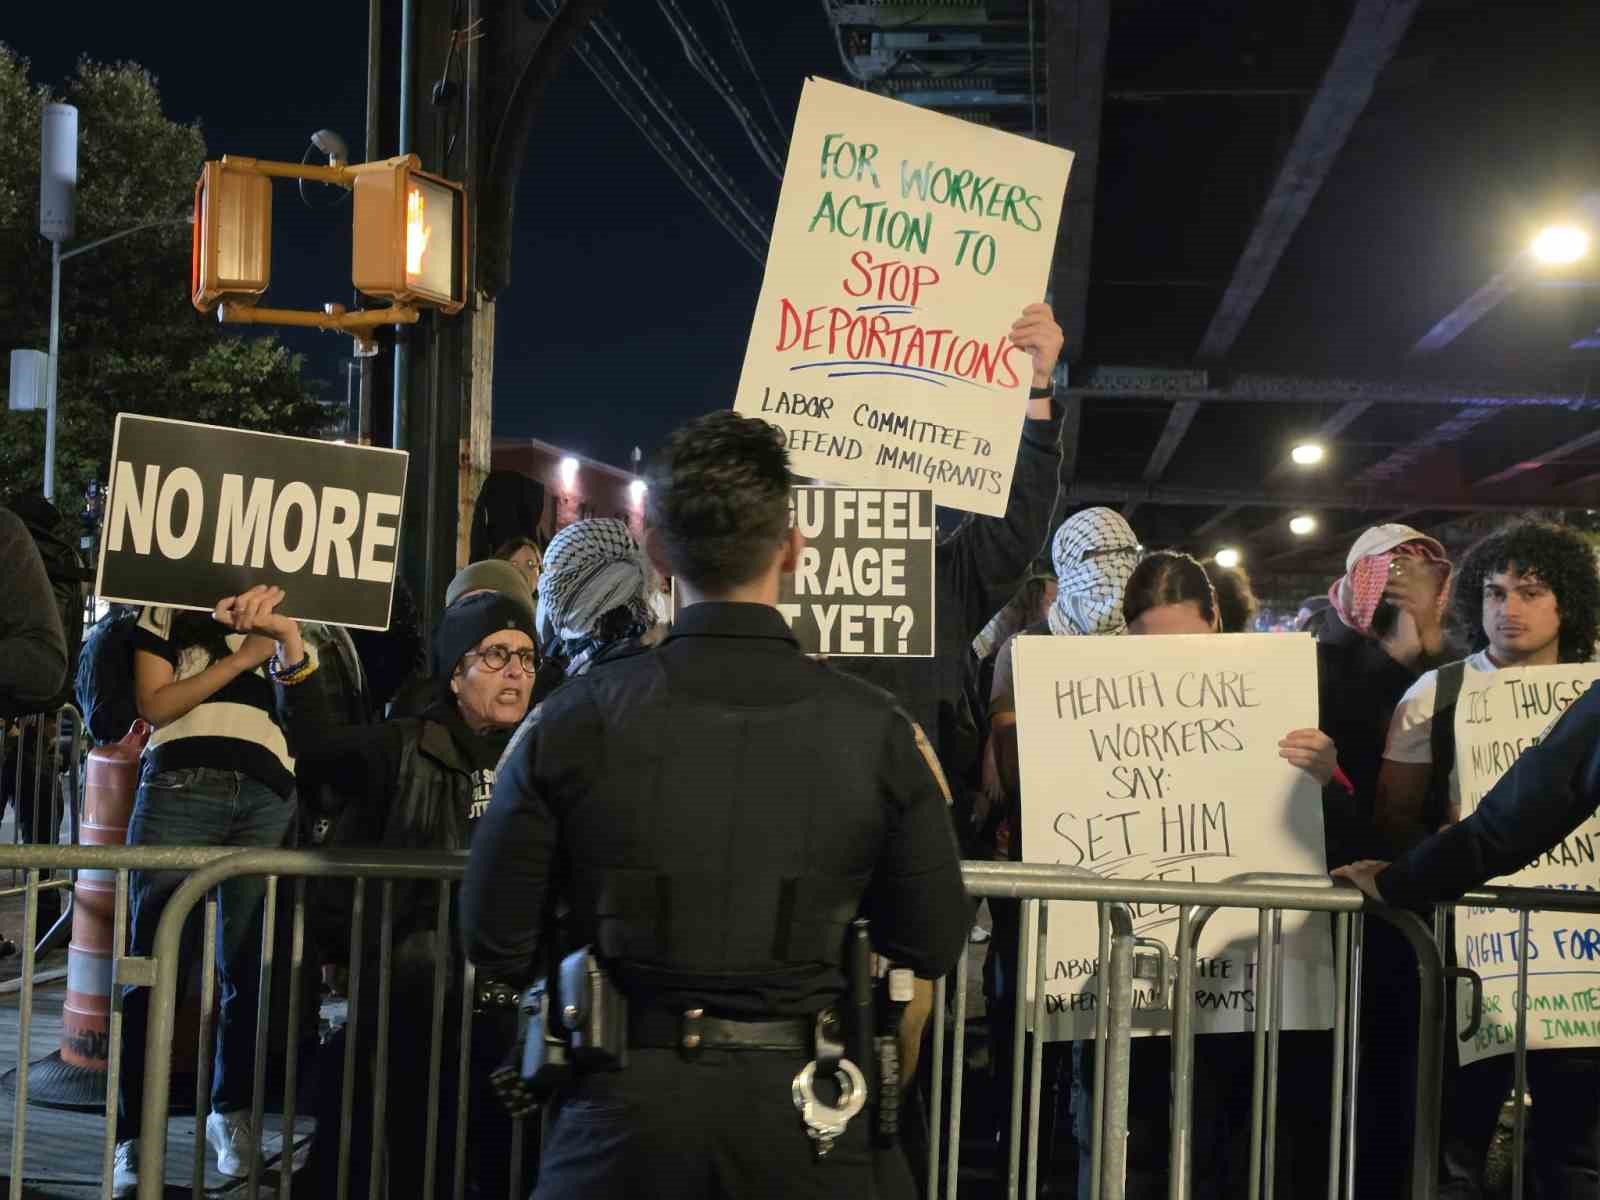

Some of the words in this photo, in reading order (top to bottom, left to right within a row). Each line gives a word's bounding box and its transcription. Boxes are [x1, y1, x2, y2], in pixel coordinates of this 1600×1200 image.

[820, 133, 880, 189] FOR
[901, 160, 1042, 232] WORKERS
[808, 191, 932, 254] ACTION
[954, 230, 995, 276] TO
[843, 251, 940, 306] STOP
[776, 299, 1019, 388] DEPORTATIONS
[761, 387, 834, 419] LABOR
[853, 403, 970, 450] COMMITTEE
[876, 443, 1002, 495] IMMIGRANTS
[107, 461, 204, 560] NO
[212, 473, 401, 583] MORE
[834, 491, 932, 540] FEEL
[811, 603, 914, 654] YET?
[1055, 670, 1165, 721] HEALTH
[1176, 671, 1263, 708] CARE
[1465, 687, 1497, 724] ICE
[1089, 718, 1243, 762] WORKERS
[1106, 766, 1172, 800] SAY:
[1053, 811, 1141, 866] SET
[1160, 801, 1230, 857] HIM
[1553, 928, 1600, 960] FOR
[1045, 992, 1097, 1015] DEFEN
